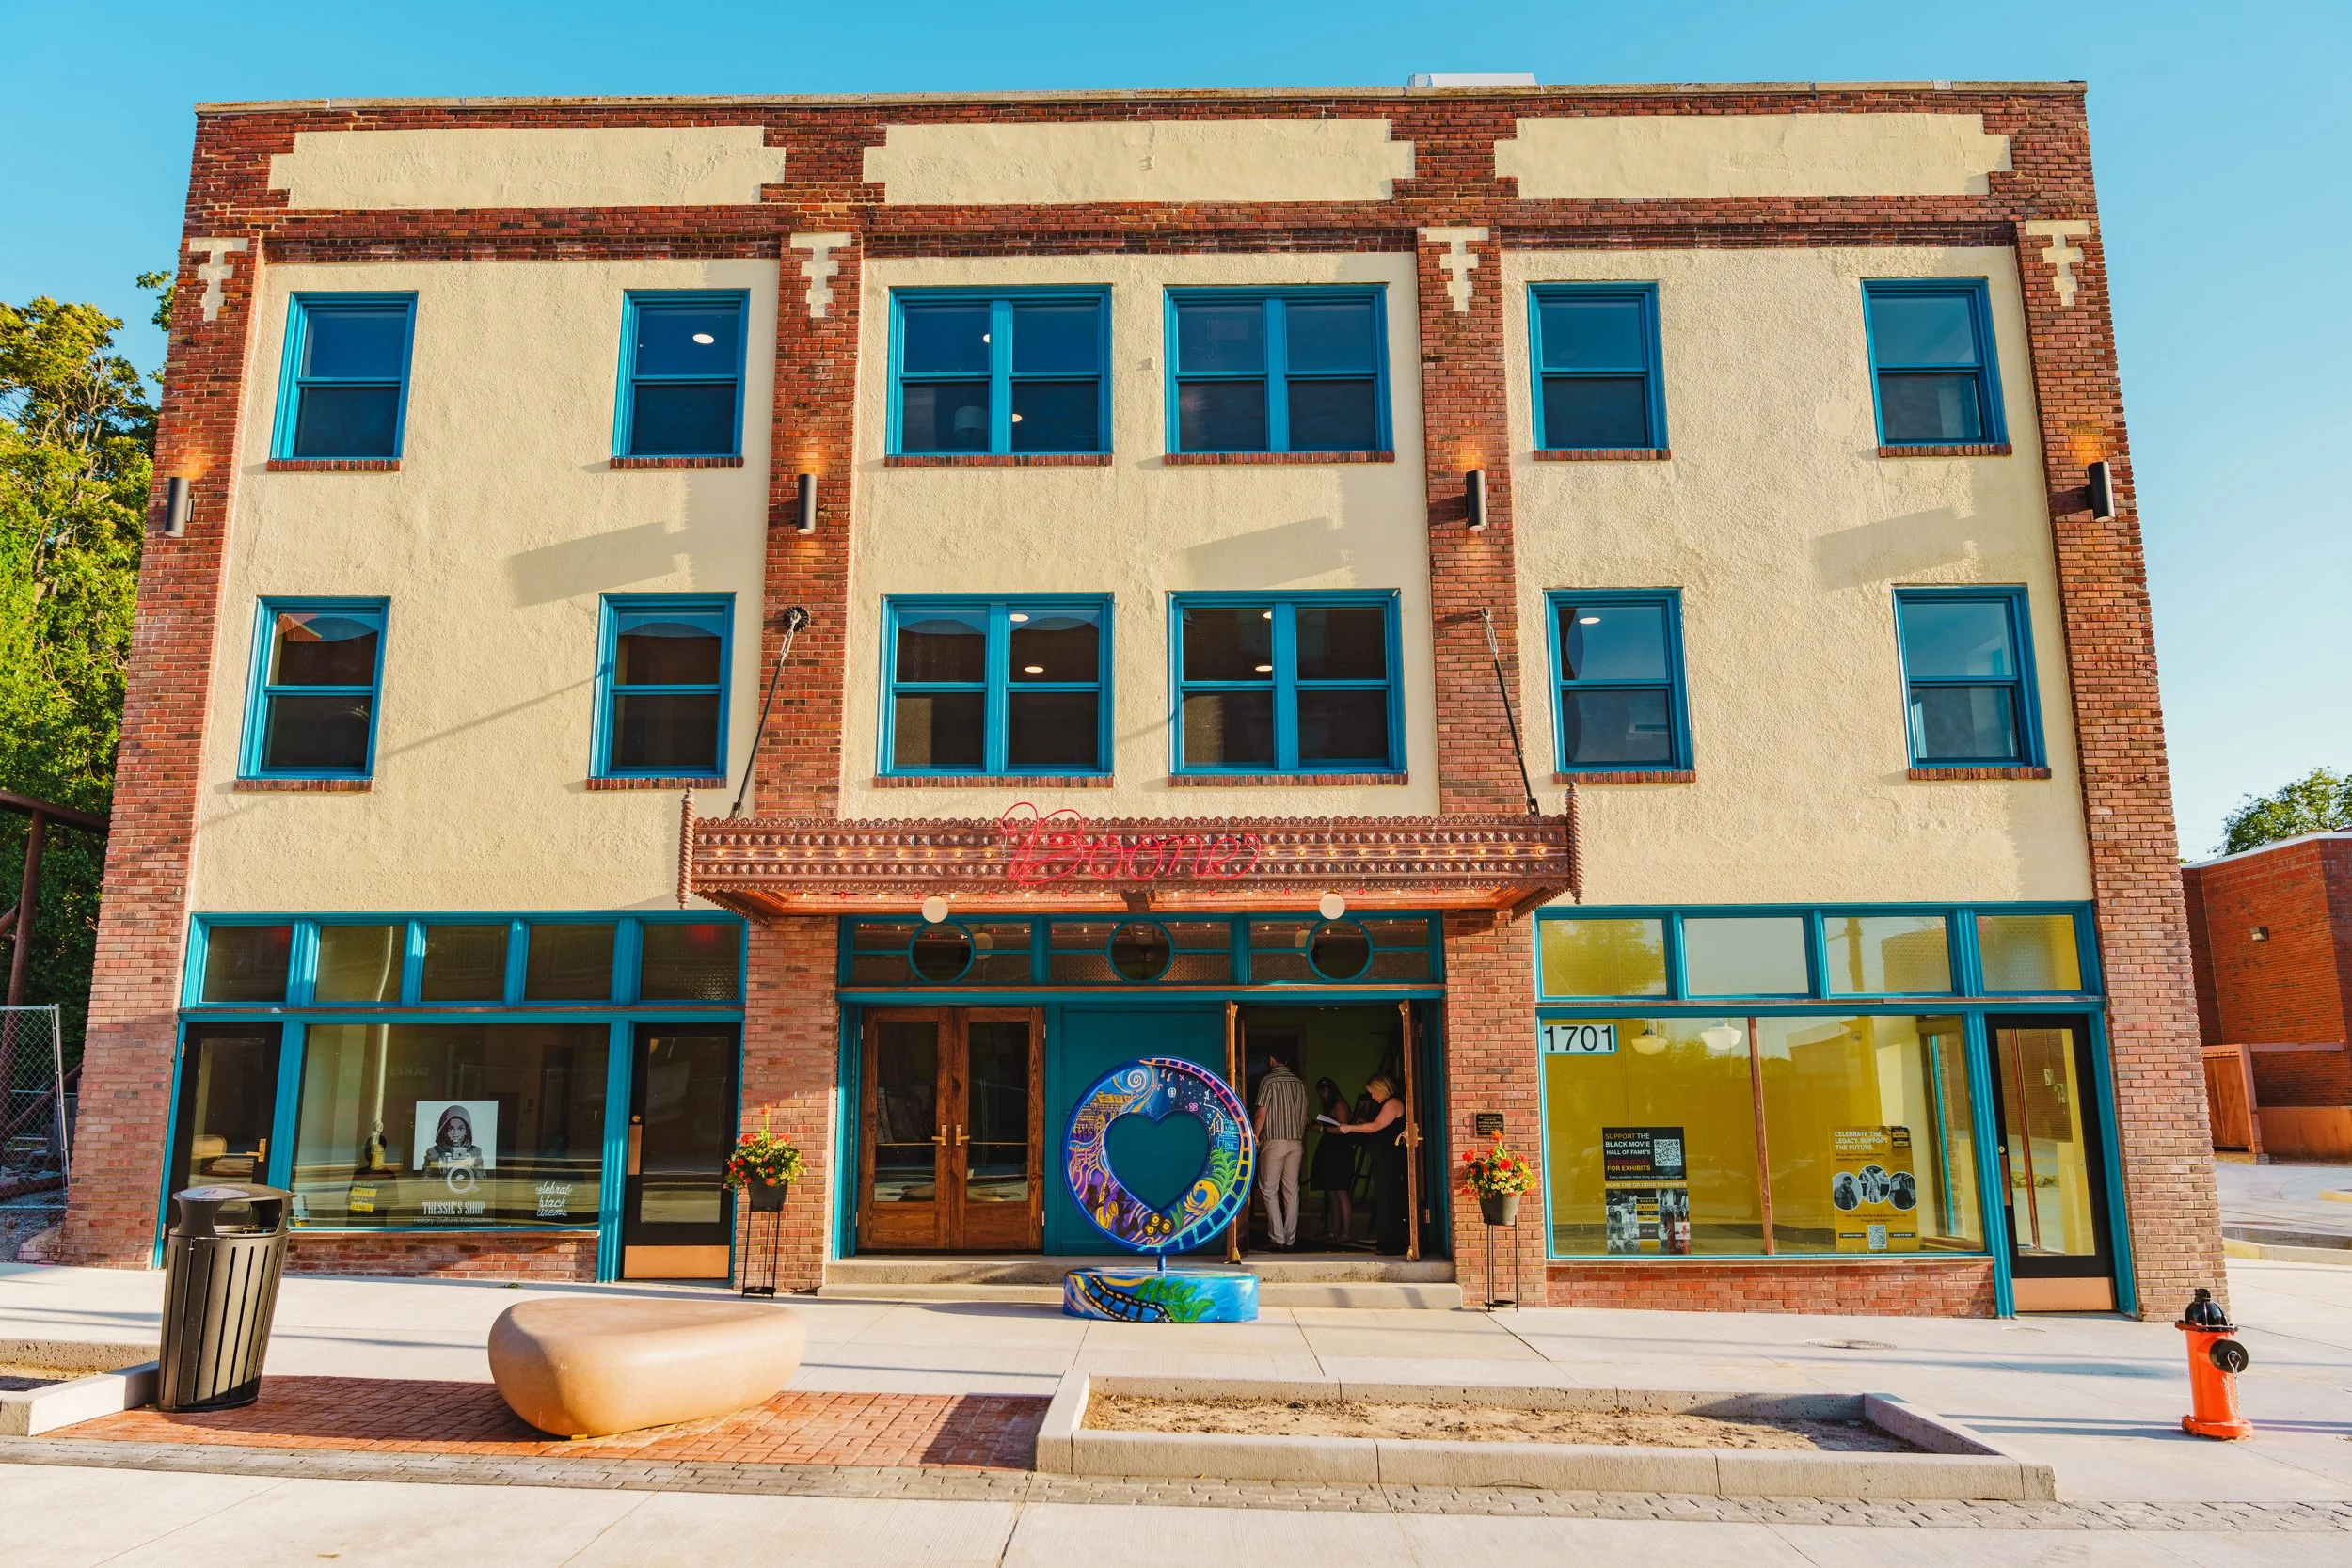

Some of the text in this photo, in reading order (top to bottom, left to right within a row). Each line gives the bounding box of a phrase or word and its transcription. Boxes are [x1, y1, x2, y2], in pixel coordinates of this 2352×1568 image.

[1000, 801, 1261, 885] Boone
[1544, 1025, 1612, 1052] 1701
[536, 1181, 572, 1195] celebrate
[539, 1194, 567, 1207] black
[422, 1201, 485, 1215] TRESSIE'S SHOP
[537, 1208, 569, 1217] cinema
